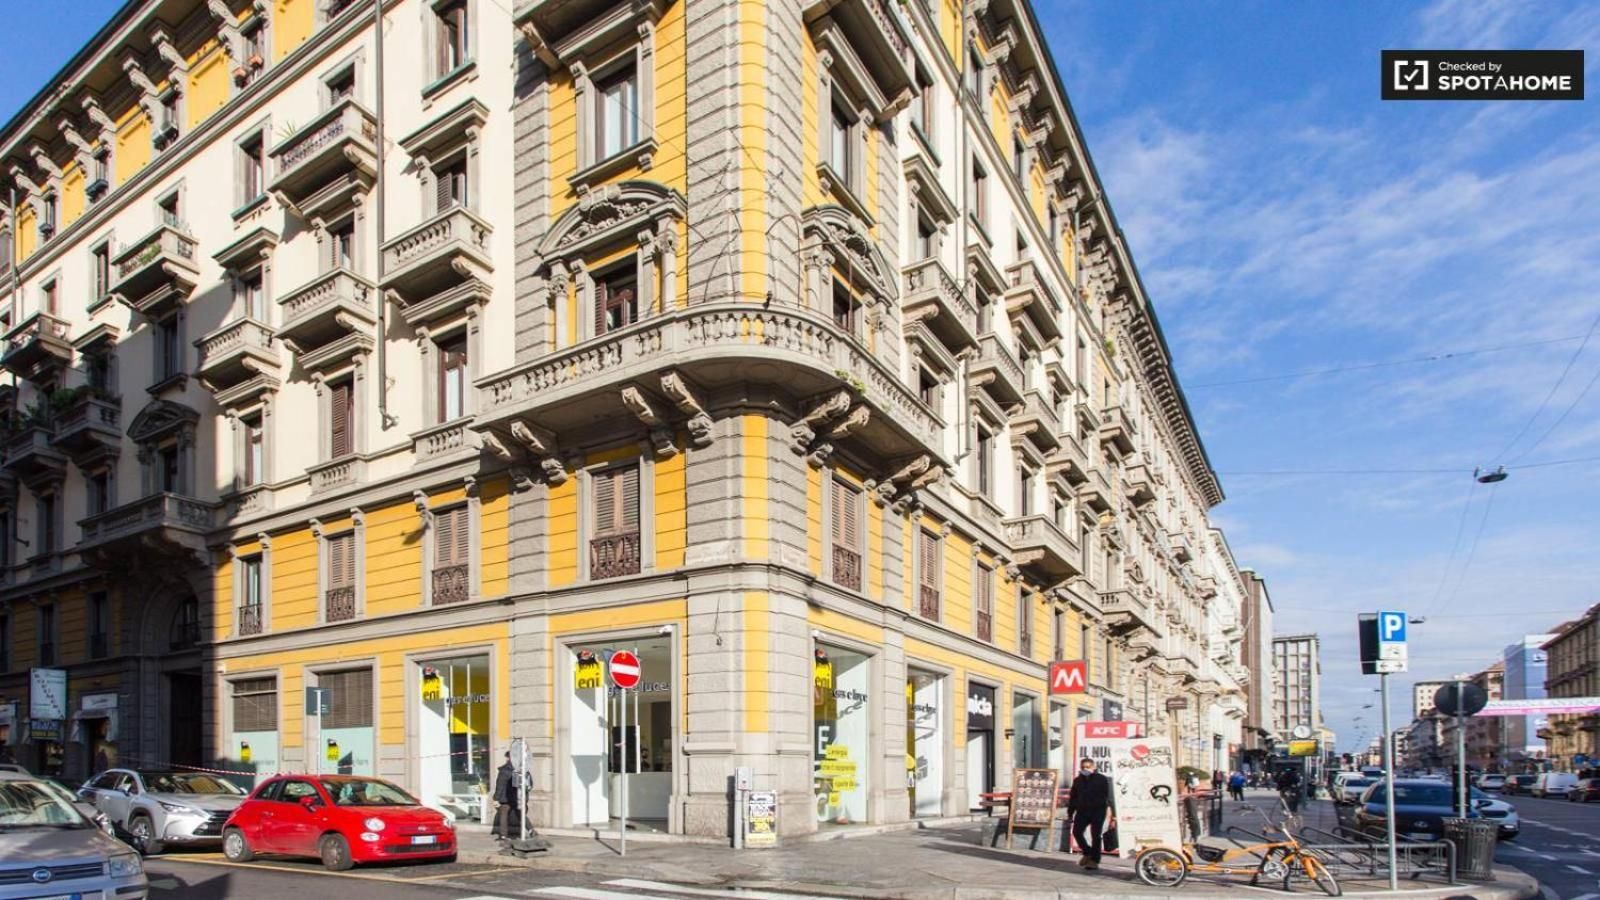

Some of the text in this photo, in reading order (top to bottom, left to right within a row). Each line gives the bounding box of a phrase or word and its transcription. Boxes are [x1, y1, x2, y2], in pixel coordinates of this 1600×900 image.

[1384, 614, 1403, 640] P
[578, 672, 600, 690] eni
[1053, 668, 1085, 689] M
[1092, 726, 1121, 736] KFC
